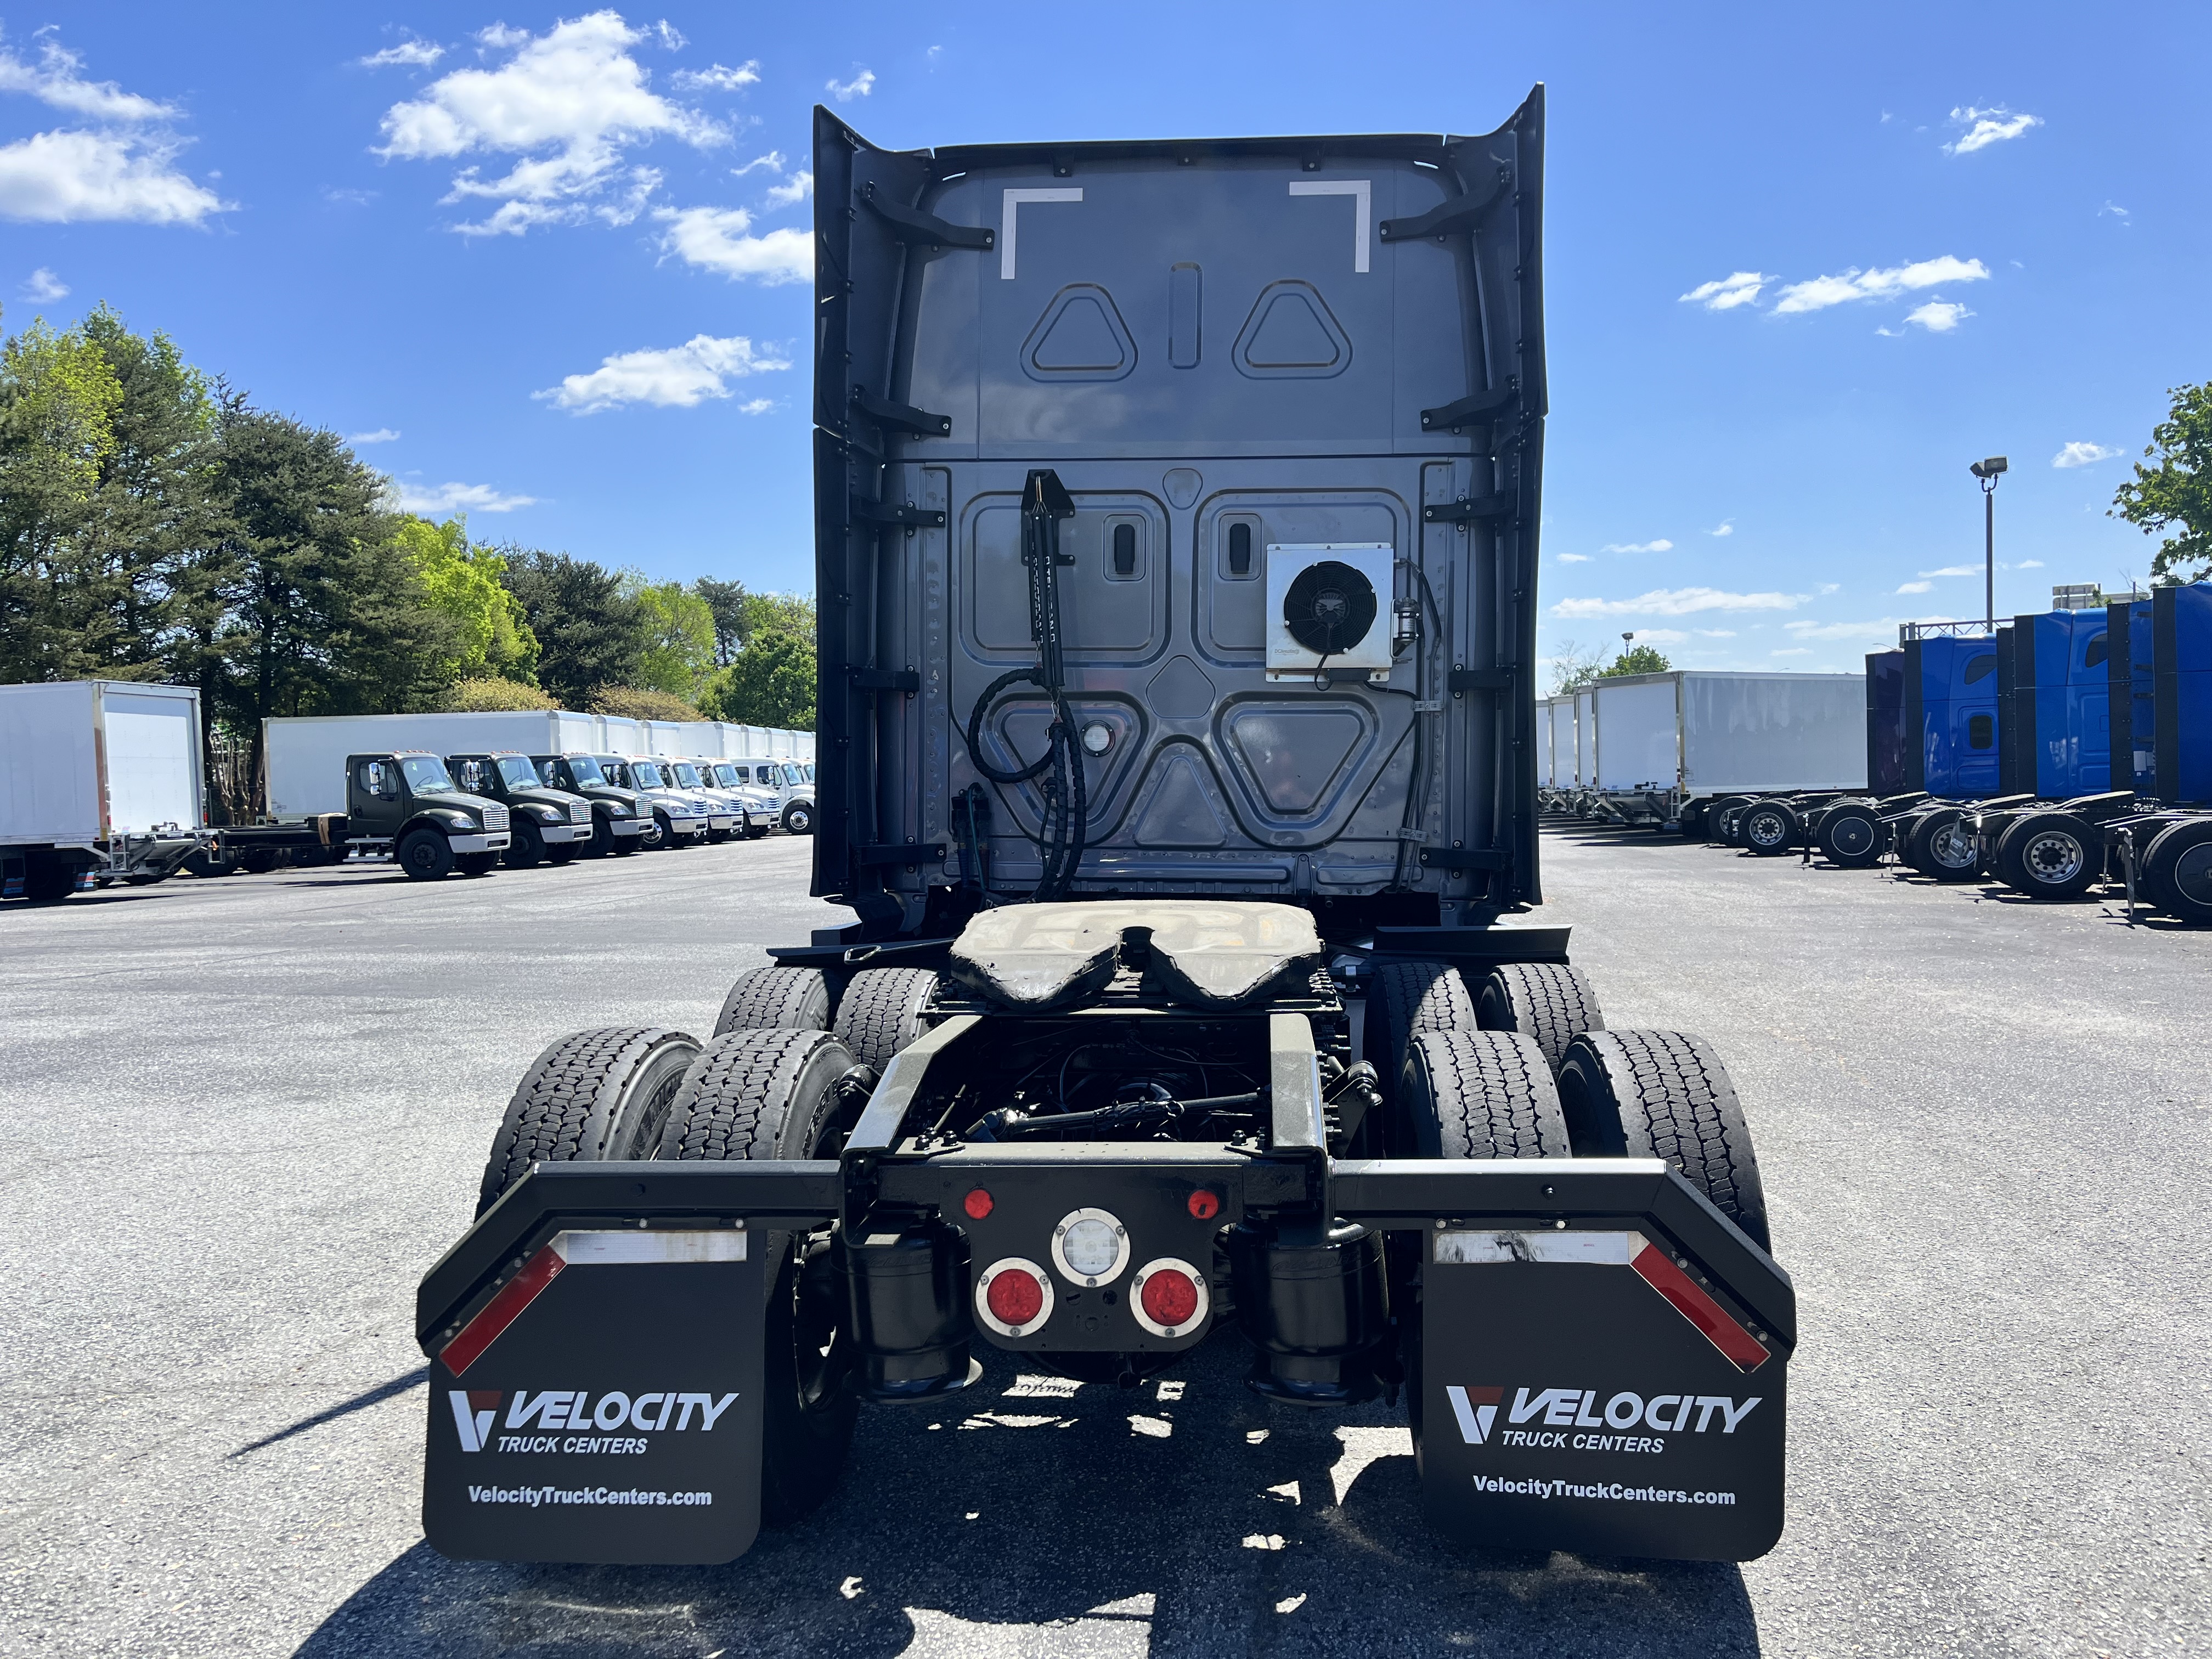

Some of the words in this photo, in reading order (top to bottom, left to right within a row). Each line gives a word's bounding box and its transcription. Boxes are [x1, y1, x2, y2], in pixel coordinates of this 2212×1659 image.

[505, 1390, 740, 1431] VELOCITY
[1509, 1387, 1763, 1434] VELOCITY
[498, 1436, 561, 1453] TRUCK
[563, 1437, 648, 1454] CENTERS
[1502, 1430, 1568, 1448] TRUCK
[1573, 1434, 1664, 1453] CENTERS
[468, 1485, 712, 1508] VelocityTruckCenters.com
[1472, 1475, 1735, 1505] VelocityTruckCenters.com
